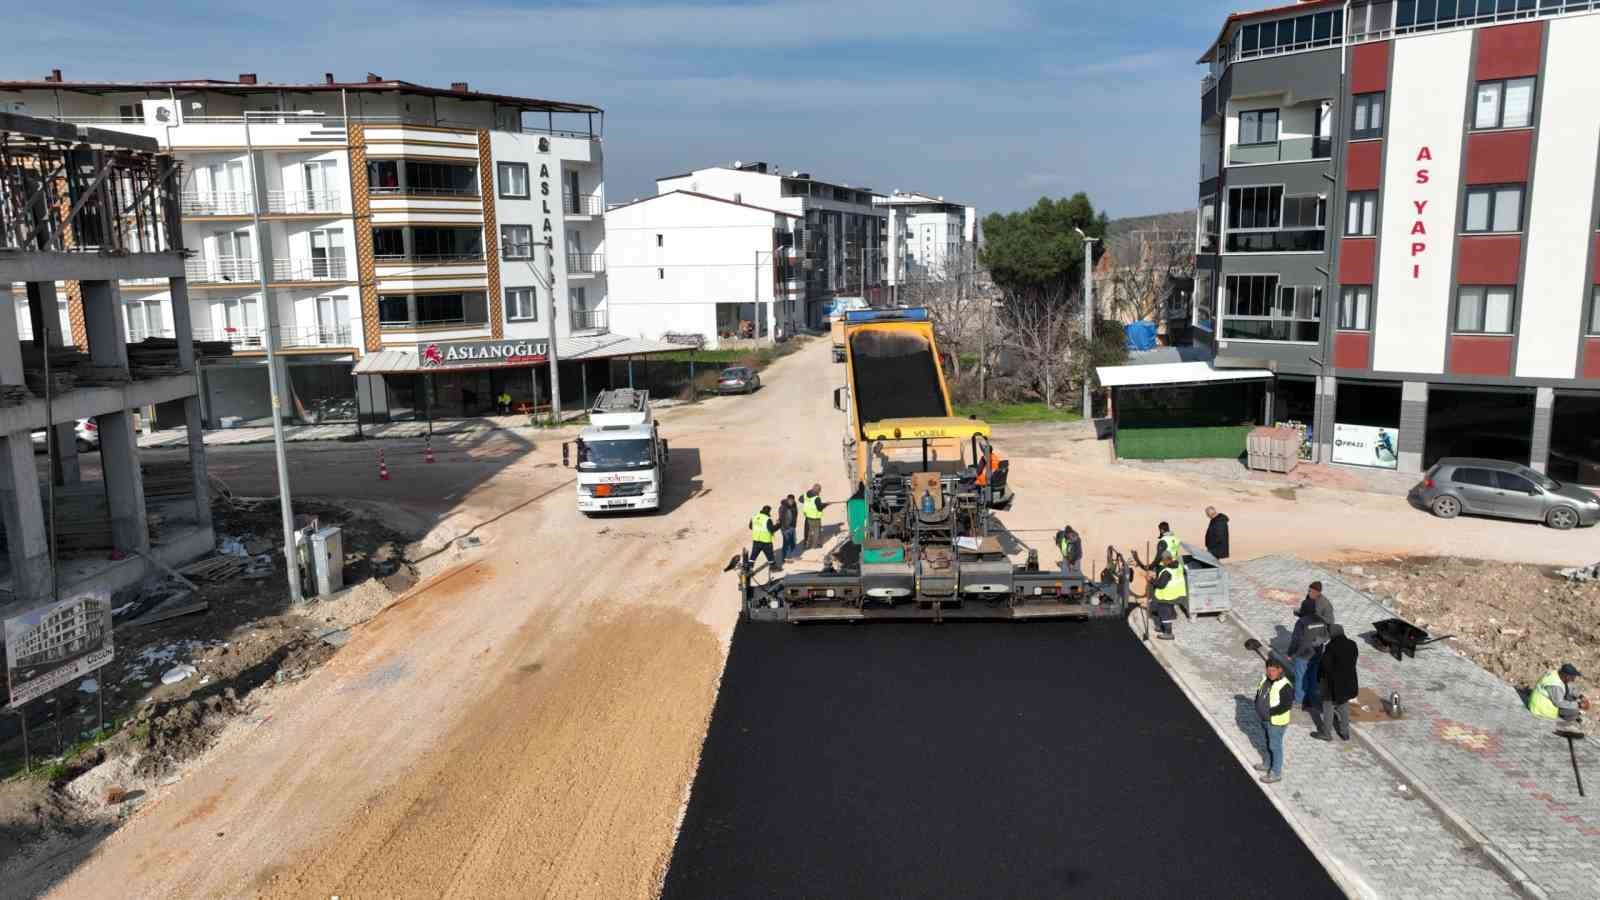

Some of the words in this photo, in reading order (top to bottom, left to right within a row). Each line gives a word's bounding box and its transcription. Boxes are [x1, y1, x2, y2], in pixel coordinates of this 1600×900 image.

[1416, 146, 1432, 184] AS
[1410, 200, 1428, 279] YAPI
[446, 341, 547, 360] ASLANOĞLU
